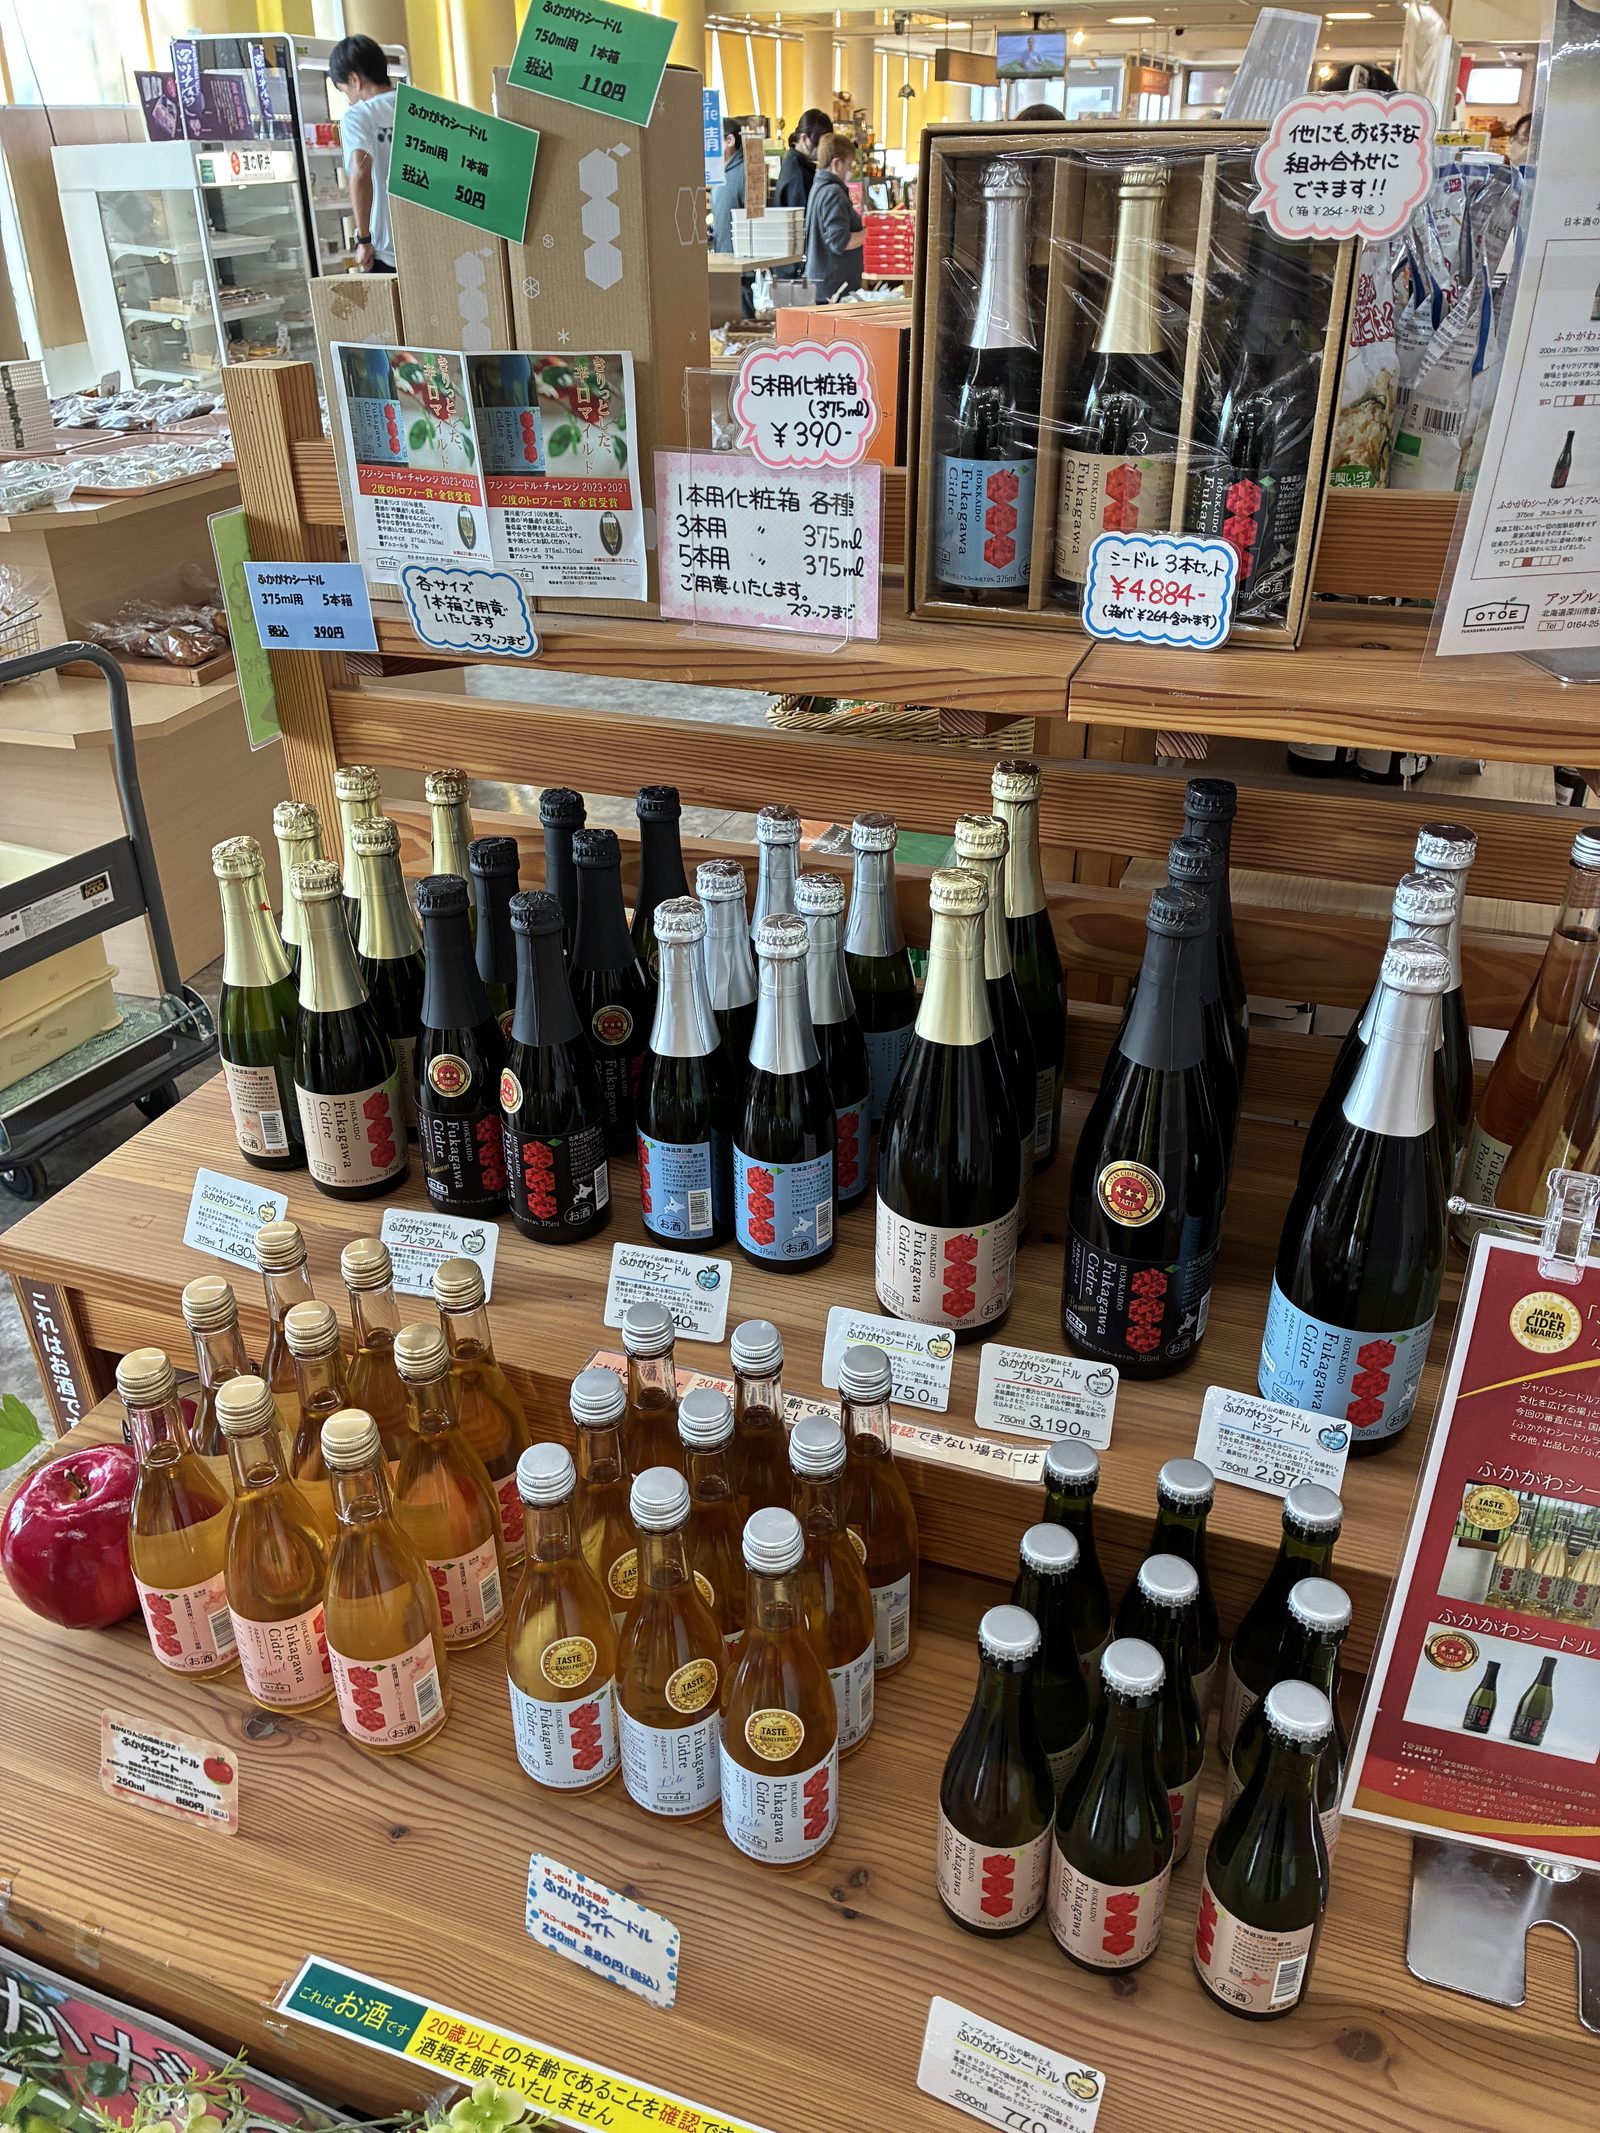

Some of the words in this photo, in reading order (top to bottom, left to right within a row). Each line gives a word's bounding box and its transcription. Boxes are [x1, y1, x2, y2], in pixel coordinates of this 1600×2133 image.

[542, 1, 623, 34] ふかがわシードル
[535, 28, 579, 52] 750ml用
[590, 44, 621, 65] 1本箱
[525, 56, 553, 79] 税込
[580, 73, 627, 101] 110円
[408, 103, 488, 142] ふかがわシードル
[405, 135, 448, 161] 375ml用
[460, 155, 489, 177] 1本箱
[1283, 150, 1399, 174] 組み合わせに
[402, 164, 429, 189] 税込
[455, 185, 486, 209] 50円
[751, 374, 858, 397] 5本用化粧箱
[423, 364, 448, 468] 辛口マイルド
[573, 365, 595, 475] 辛口マイルド
[809, 400, 870, 418] (375ml)
[948, 467, 958, 515] Cidre
[1065, 460, 1076, 511] Cidre
[1090, 464, 1099, 519] HOKKAIDO
[677, 484, 800, 512] 1本用化粧箱
[809, 490, 854, 517] 各種
[957, 468, 973, 555] Fukagawa
[1071, 461, 1090, 554] Fukagawa
[1212, 478, 1223, 532] HOKKAIDO
[676, 514, 727, 538] 3本用
[803, 524, 862, 550] 375ml
[679, 544, 730, 570] 5本用
[803, 555, 865, 578] 375ml
[1165, 553, 1224, 576] 3本セット
[258, 573, 325, 587] ふかがわシードル
[416, 575, 473, 594] 各サイズ
[680, 575, 808, 601] ご用意いたします。
[261, 593, 304, 606] 375ml用
[323, 593, 353, 607] 5本箱
[786, 603, 855, 620] スタッフまで
[435, 613, 495, 629] いたします
[1475, 610, 1519, 622] OTOE
[1545, 622, 1557, 630] Tel
[268, 625, 289, 638] 税込
[314, 625, 345, 639] 390円
[470, 633, 526, 646] スタッフまで
[604, 1060, 618, 1123] Fukagawa
[319, 1101, 333, 1138] Cidre
[349, 1100, 361, 1140] HOKKAIDO
[334, 1101, 352, 1168] Fukagawa
[432, 1119, 446, 1158] Cidre
[462, 1120, 473, 1162] HOKKAIDO
[447, 1121, 464, 1189] Fukagawa
[505, 1129, 516, 1199] Fukagawa
[513, 1136, 521, 1178] HOKKAIDO
[201, 1190, 256, 1215] ふかがわシードル
[569, 1207, 591, 1222] お酒
[1117, 1196, 1137, 1208] TASTE
[389, 1222, 458, 1240] ふかがわシードル
[660, 1218, 682, 1231] お酒
[401, 1234, 443, 1248] プレミアム
[786, 1239, 810, 1254] お酒
[899, 1224, 911, 1266] Cidre
[619, 1256, 691, 1276] ふかがわシードル
[910, 1229, 927, 1303] Fukagawa
[930, 1233, 938, 1278] HOKKAIDO
[643, 1271, 668, 1283] ドライ
[1085, 1252, 1100, 1296] Cidre
[1117, 1265, 1128, 1311] HOKKAIDO
[984, 1299, 1004, 1316] お酒
[1096, 1258, 1117, 1335] Fukagawa
[955, 1317, 976, 1327] 750ml
[1526, 1315, 1566, 1333] CIDER
[1532, 1308, 1563, 1320] JAPAN
[847, 1329, 923, 1352] ふかがわシードル
[1300, 1324, 1319, 1369] Cidre
[1523, 1326, 1564, 1340] AWARDS
[998, 1358, 1082, 1380] ふかがわシードル
[1000, 1350, 1073, 1368] アップルランド山の駅おとえ
[1311, 1332, 1340, 1410] Fukagawa
[1337, 1337, 1352, 1385] HOKKAIDO
[1012, 1370, 1064, 1389] プレミアム
[1279, 1370, 1306, 1391] Dry
[999, 1413, 1025, 1425] 750ml
[1223, 1402, 1312, 1434] ふかがわシードル
[1252, 1420, 1283, 1437] ドライ
[1357, 1428, 1379, 1437] 750ml
[1220, 1460, 1249, 1475] 750ml
[1478, 1498, 1505, 1510] TASTE
[459, 1622, 482, 1635] お酒
[1438, 1608, 1597, 1655] ふかがわシードル
[269, 1628, 284, 1661] Cidre
[285, 1624, 305, 1683] Fukagawa
[189, 1654, 213, 1666] お酒
[557, 1655, 581, 1665] TASTE
[681, 1675, 705, 1691] TASTE
[392, 1723, 416, 1738] お酒
[525, 1702, 537, 1736] Cidre
[761, 1727, 787, 1736] TASTE
[539, 1707, 554, 1766] Fukagawa
[121, 1736, 200, 1769] ふかがわシードル
[141, 1754, 179, 1773] スイート
[677, 1734, 690, 1769] Cidre
[116, 1775, 145, 1792] 250ml
[176, 1795, 204, 1812] 880円
[756, 1781, 769, 1816] Cidre
[544, 1866, 571, 1886] すっきり
[543, 1878, 653, 1943] ふかがわシードル
[542, 1922, 576, 1948] 250ml
[577, 1911, 615, 1939] ライト
[1220, 1983, 1247, 2003] お酒
[299, 1986, 411, 2038] これはお酒です
[957, 2030, 1060, 2084] ふかがわシードル
[961, 2021, 1052, 2068] アップルランド山の駅おとえ
[954, 2089, 988, 2111] 200ml
